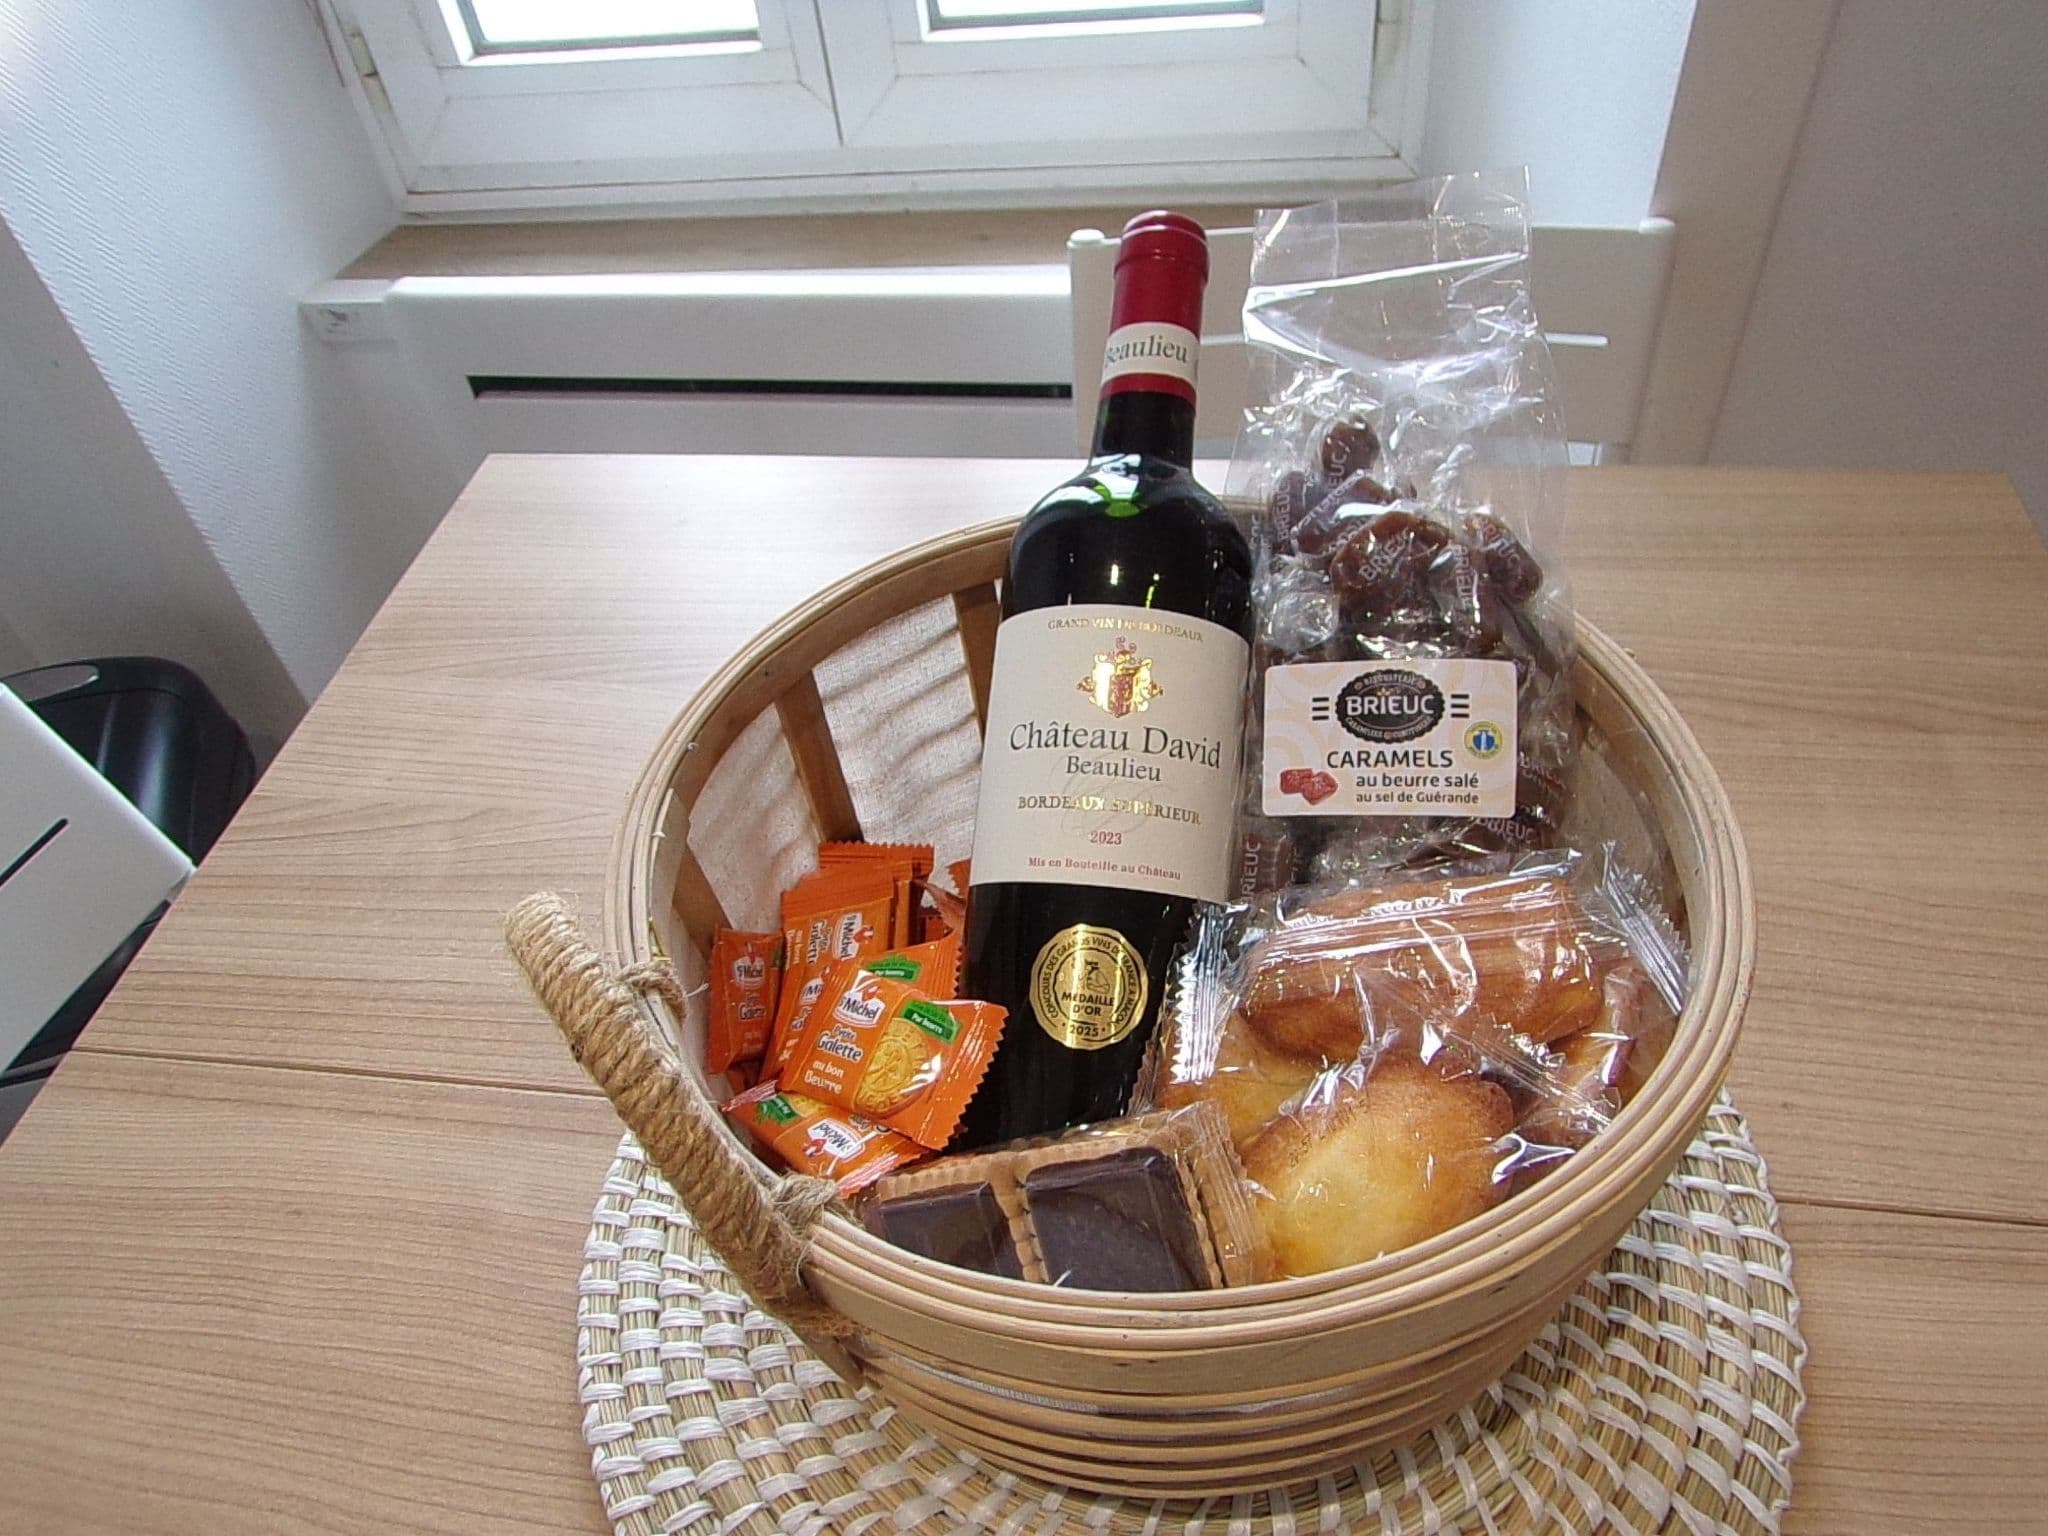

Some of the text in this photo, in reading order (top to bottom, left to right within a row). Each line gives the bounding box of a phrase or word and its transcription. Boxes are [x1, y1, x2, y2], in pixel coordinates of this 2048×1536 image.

[1106, 333, 1187, 366] eaulieu
[1048, 618, 1089, 630] GRAND
[1092, 617, 1114, 629] VIN
[1345, 694, 1435, 716] BRIEUC
[1010, 721, 1222, 768] Château David
[1066, 755, 1162, 782] Beaulieu
[1327, 750, 1454, 769] CARAMELS
[1356, 772, 1479, 788] au beurre salé
[1018, 796, 1105, 812] BORDEAUX
[1356, 791, 1479, 803] au sel de Guérande
[1090, 831, 1122, 845] 2023
[1028, 857, 1181, 881] Mis en Bouteille au Château
[843, 997, 880, 1019] Michel
[1073, 1004, 1102, 1017] D'OR
[1069, 1024, 1100, 1037] 2025
[818, 1033, 863, 1061] Galette
[824, 1062, 845, 1078] bon
[804, 1070, 843, 1095] Beurre
